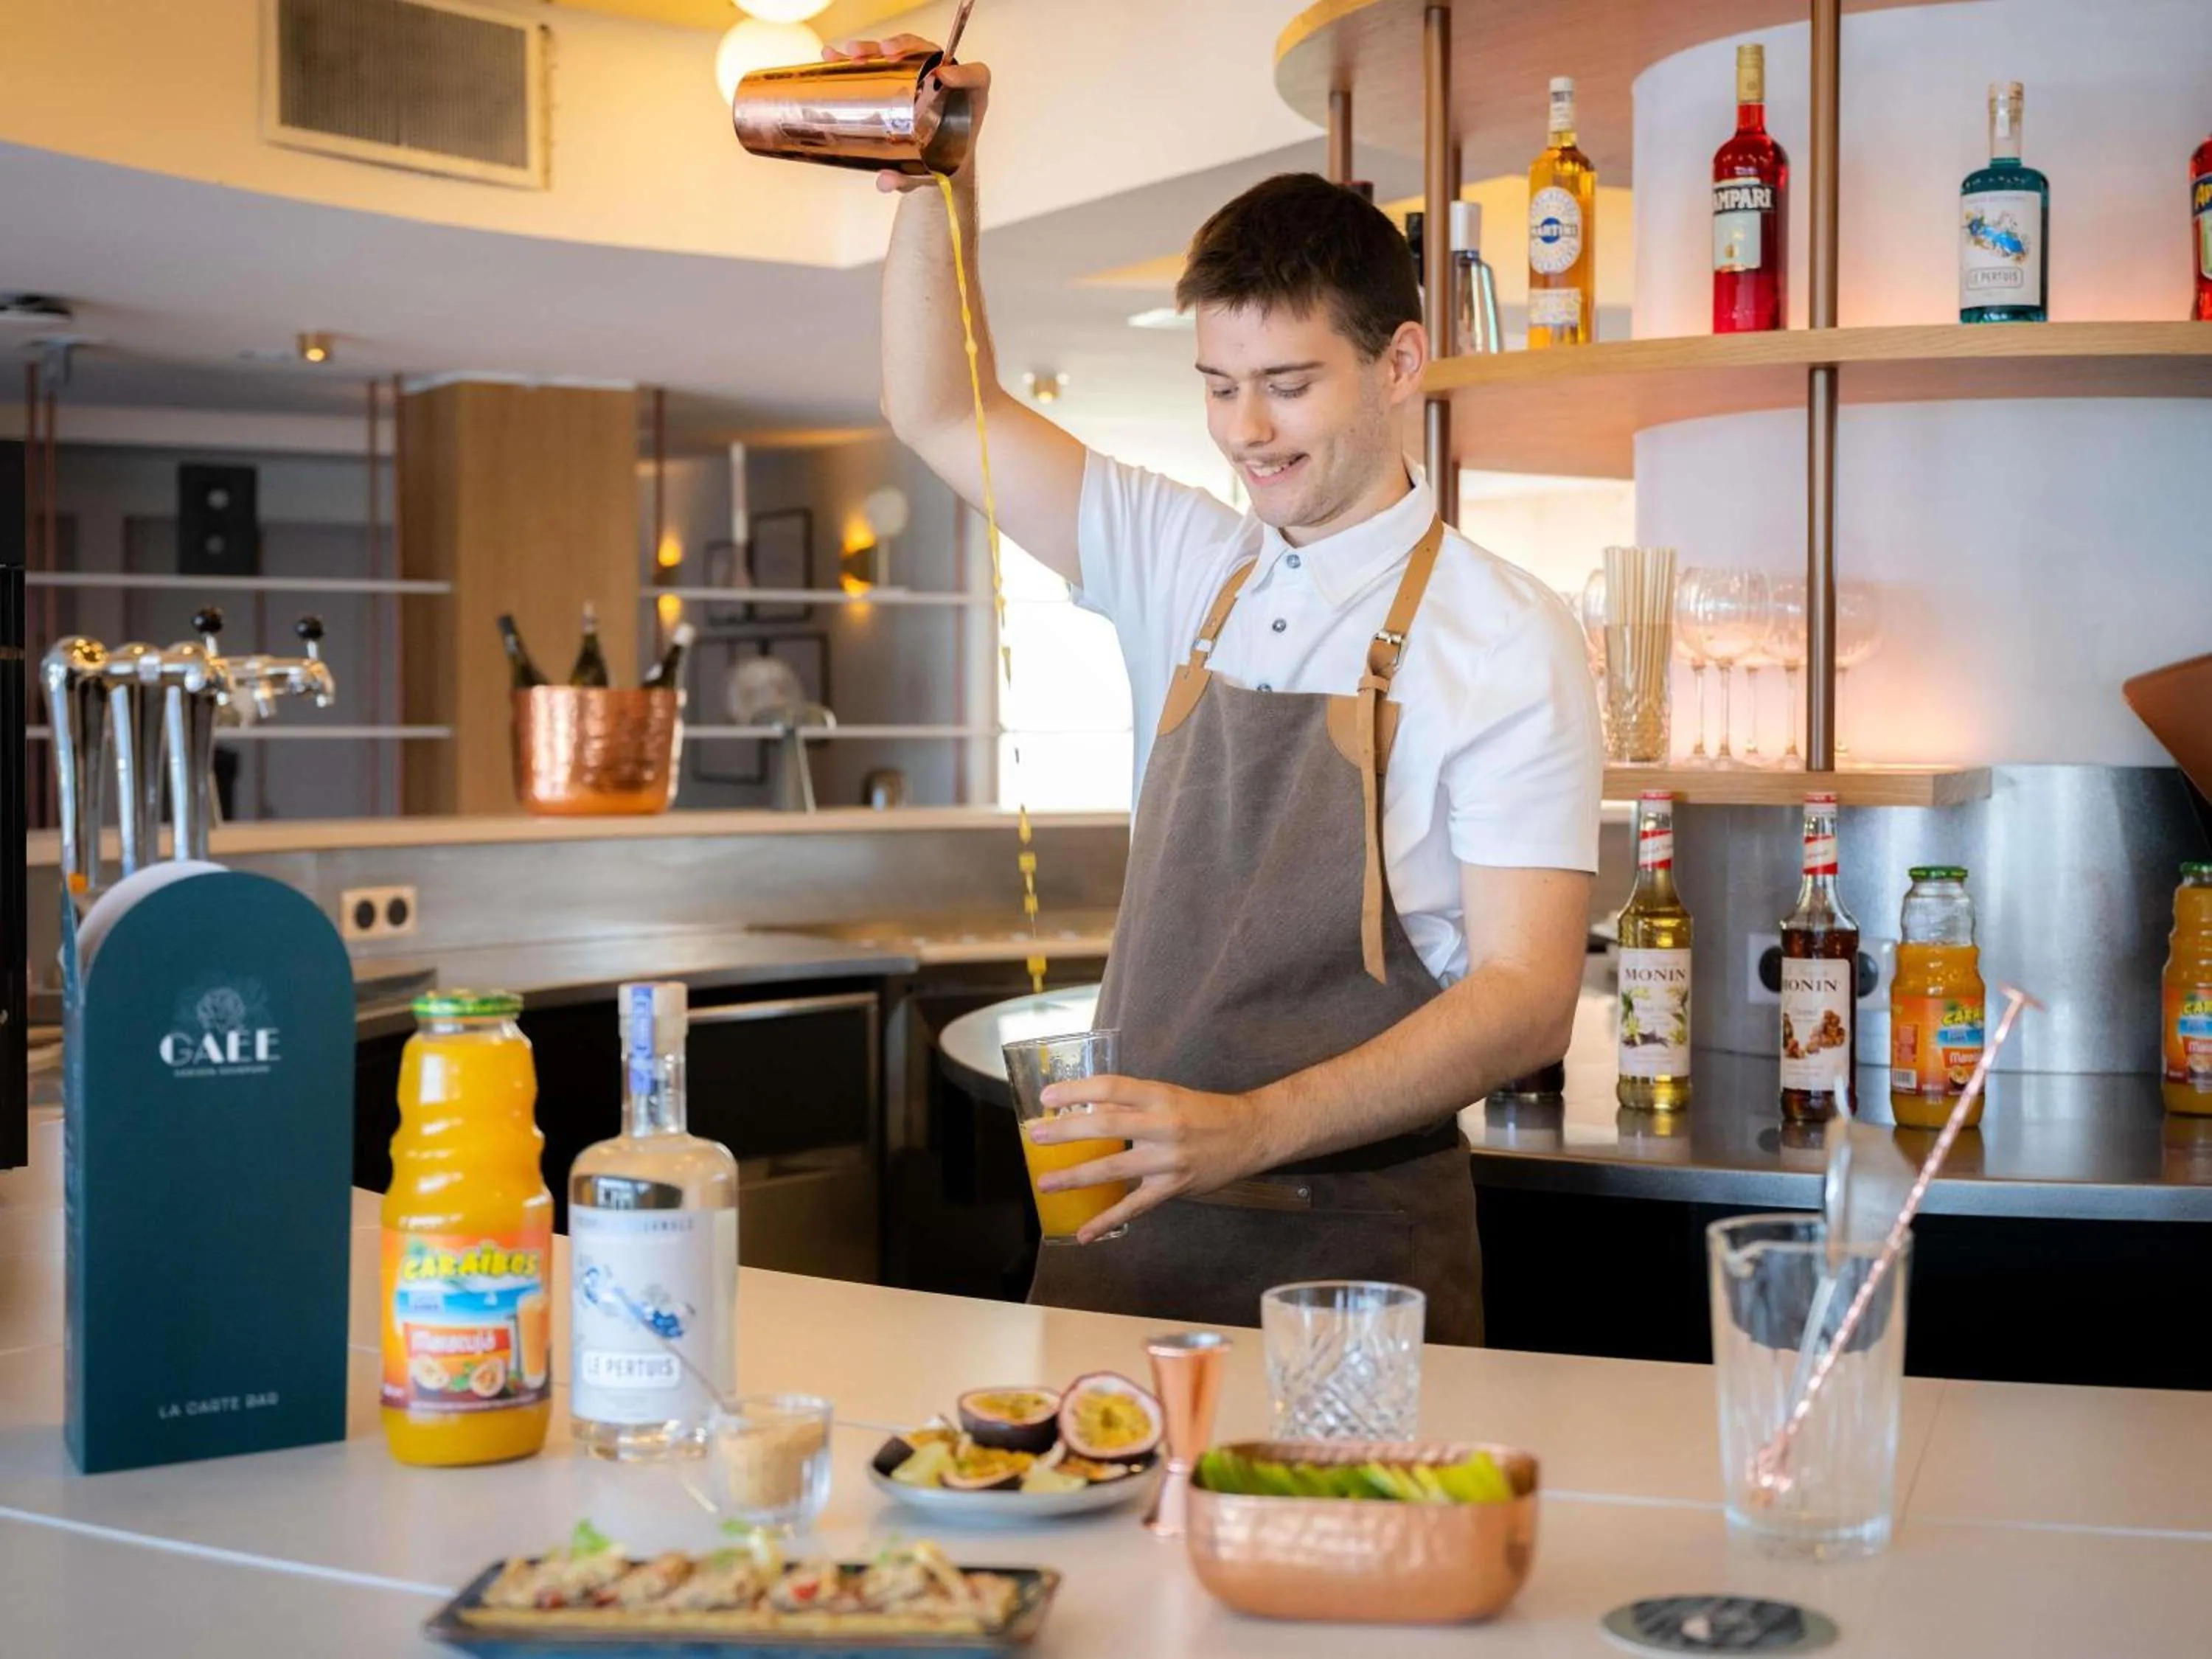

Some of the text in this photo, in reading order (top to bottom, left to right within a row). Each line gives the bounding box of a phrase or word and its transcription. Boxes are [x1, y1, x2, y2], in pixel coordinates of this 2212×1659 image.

[1625, 967, 1686, 981] MONIN
[157, 1402, 183, 1420] LA
[185, 1395, 240, 1416] CARTE
